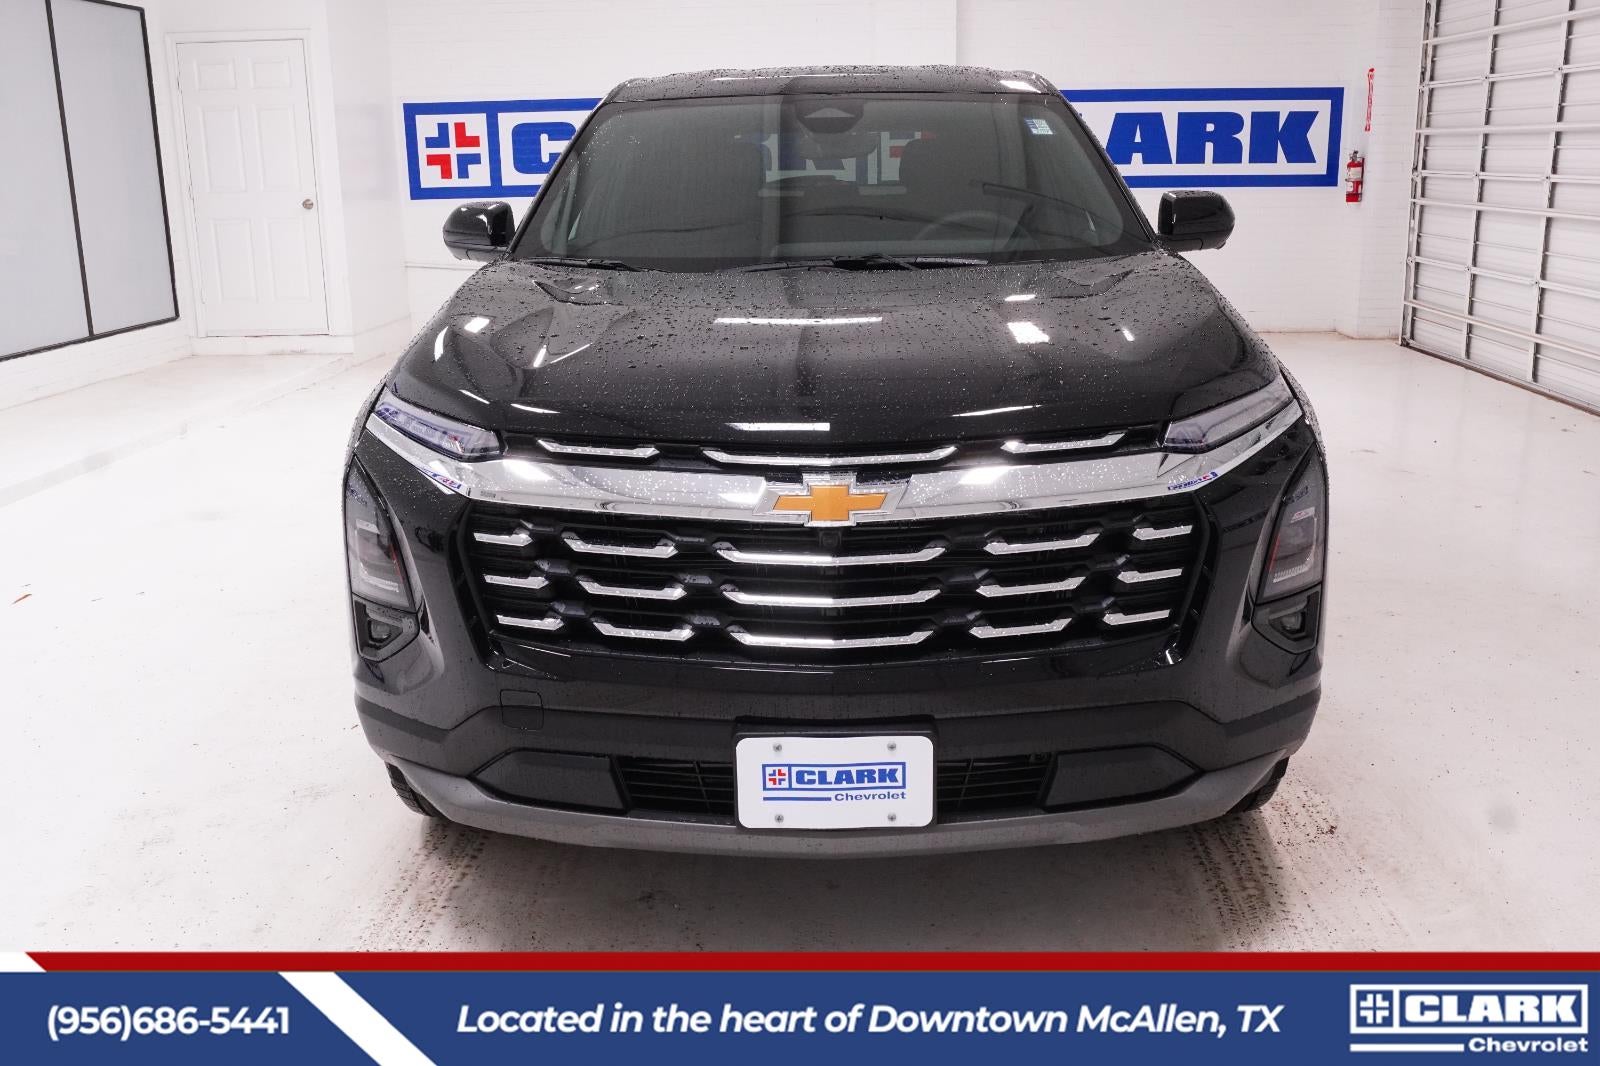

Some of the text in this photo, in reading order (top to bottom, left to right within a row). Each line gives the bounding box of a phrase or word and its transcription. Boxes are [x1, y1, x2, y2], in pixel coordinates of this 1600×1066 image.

[1104, 110, 1320, 165] ARK
[795, 768, 899, 786] CLARK
[834, 791, 906, 801] Chevrolet
